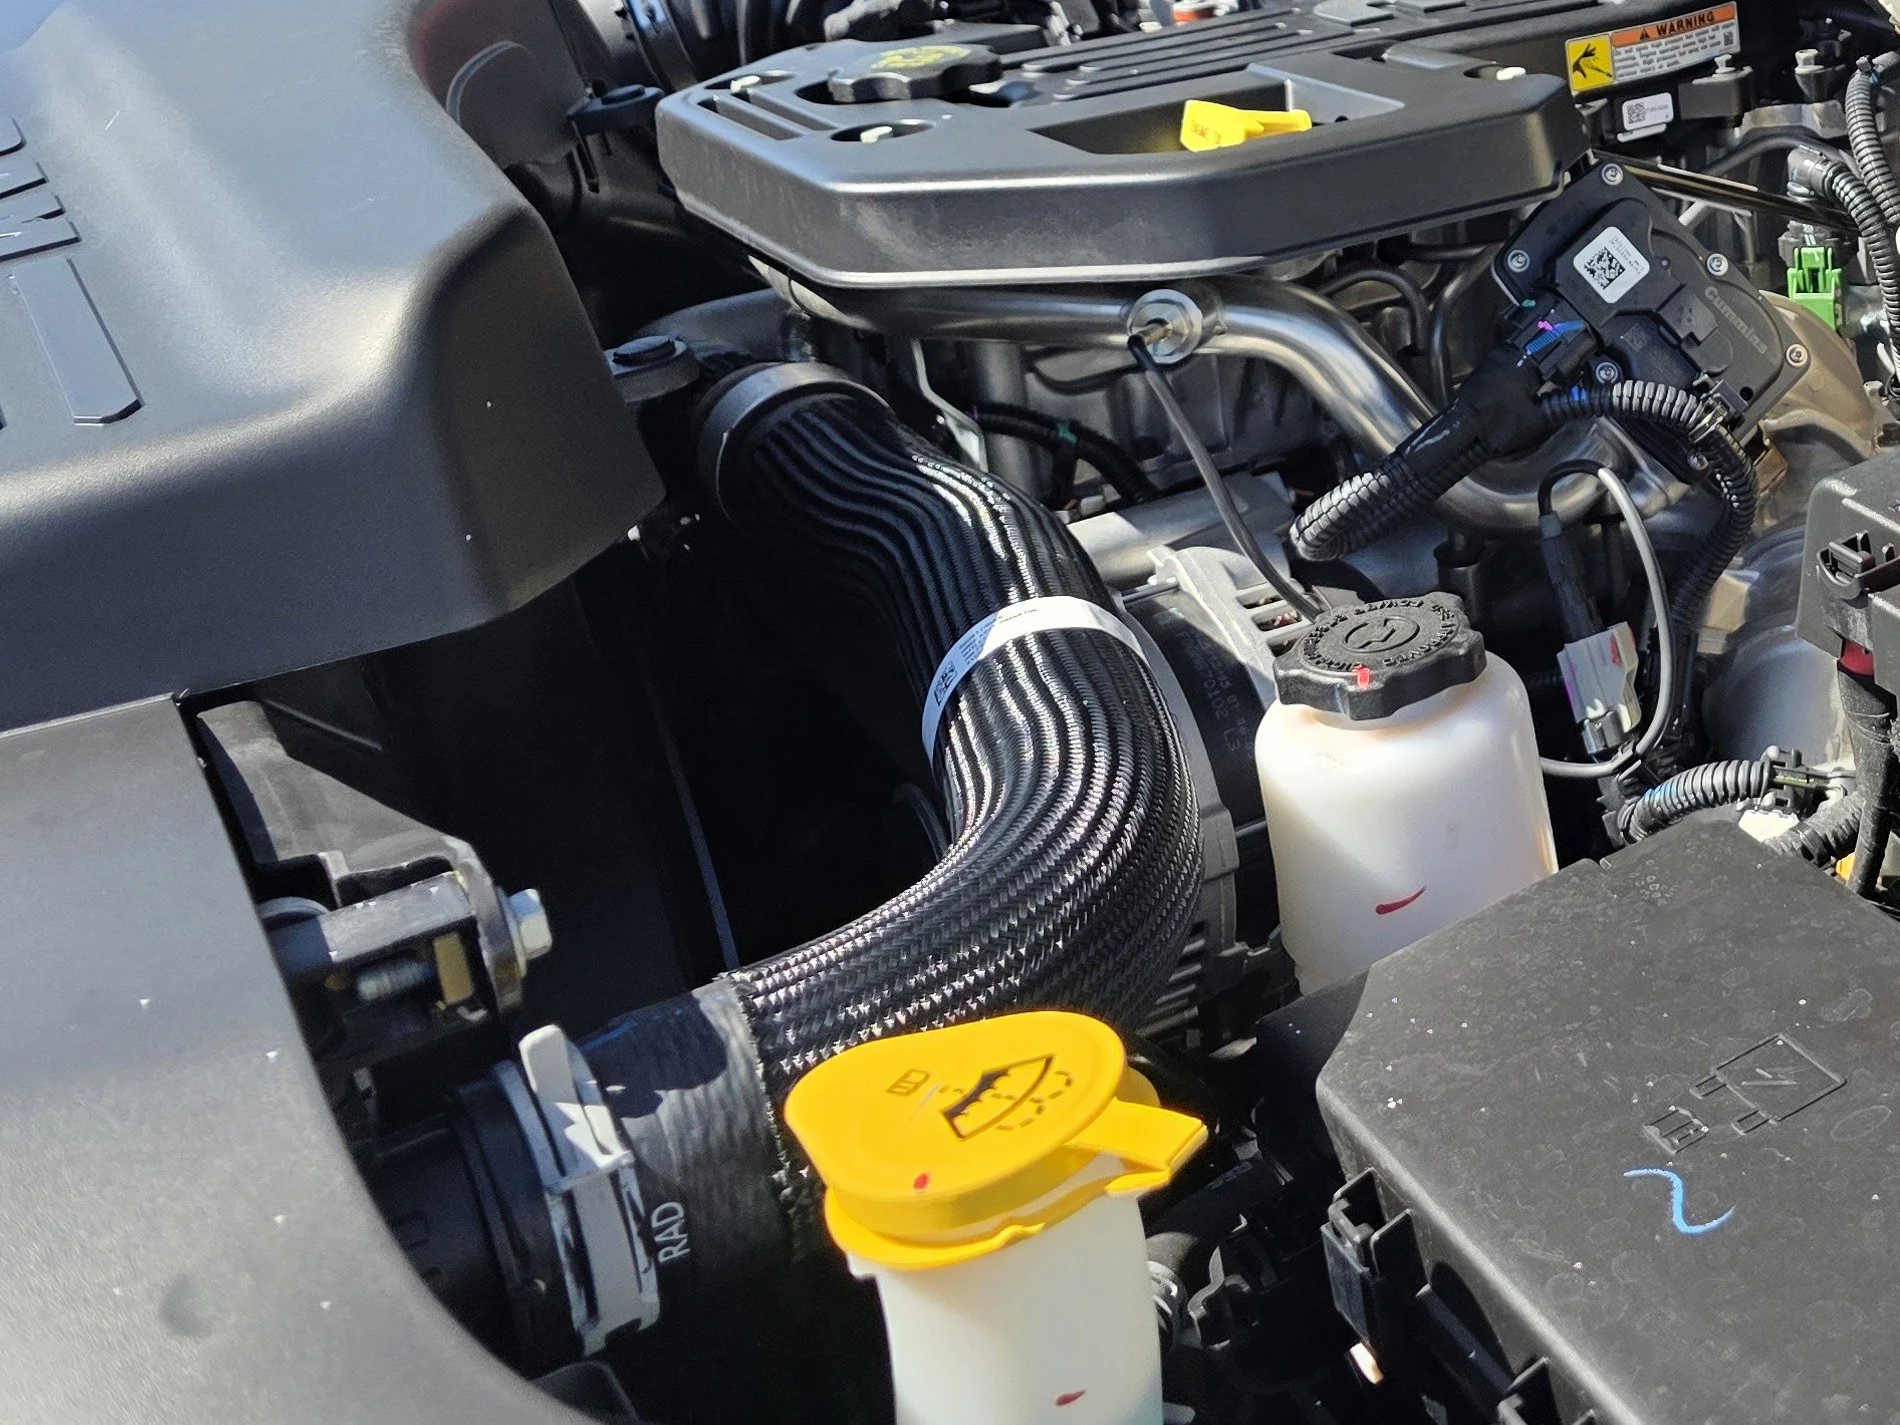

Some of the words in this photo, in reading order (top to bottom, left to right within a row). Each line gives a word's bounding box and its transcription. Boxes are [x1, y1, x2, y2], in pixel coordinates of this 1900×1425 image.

[1656, 11, 1715, 36] WARNING
[1704, 285, 1768, 354] Cummins
[651, 1202, 691, 1262] RAD
